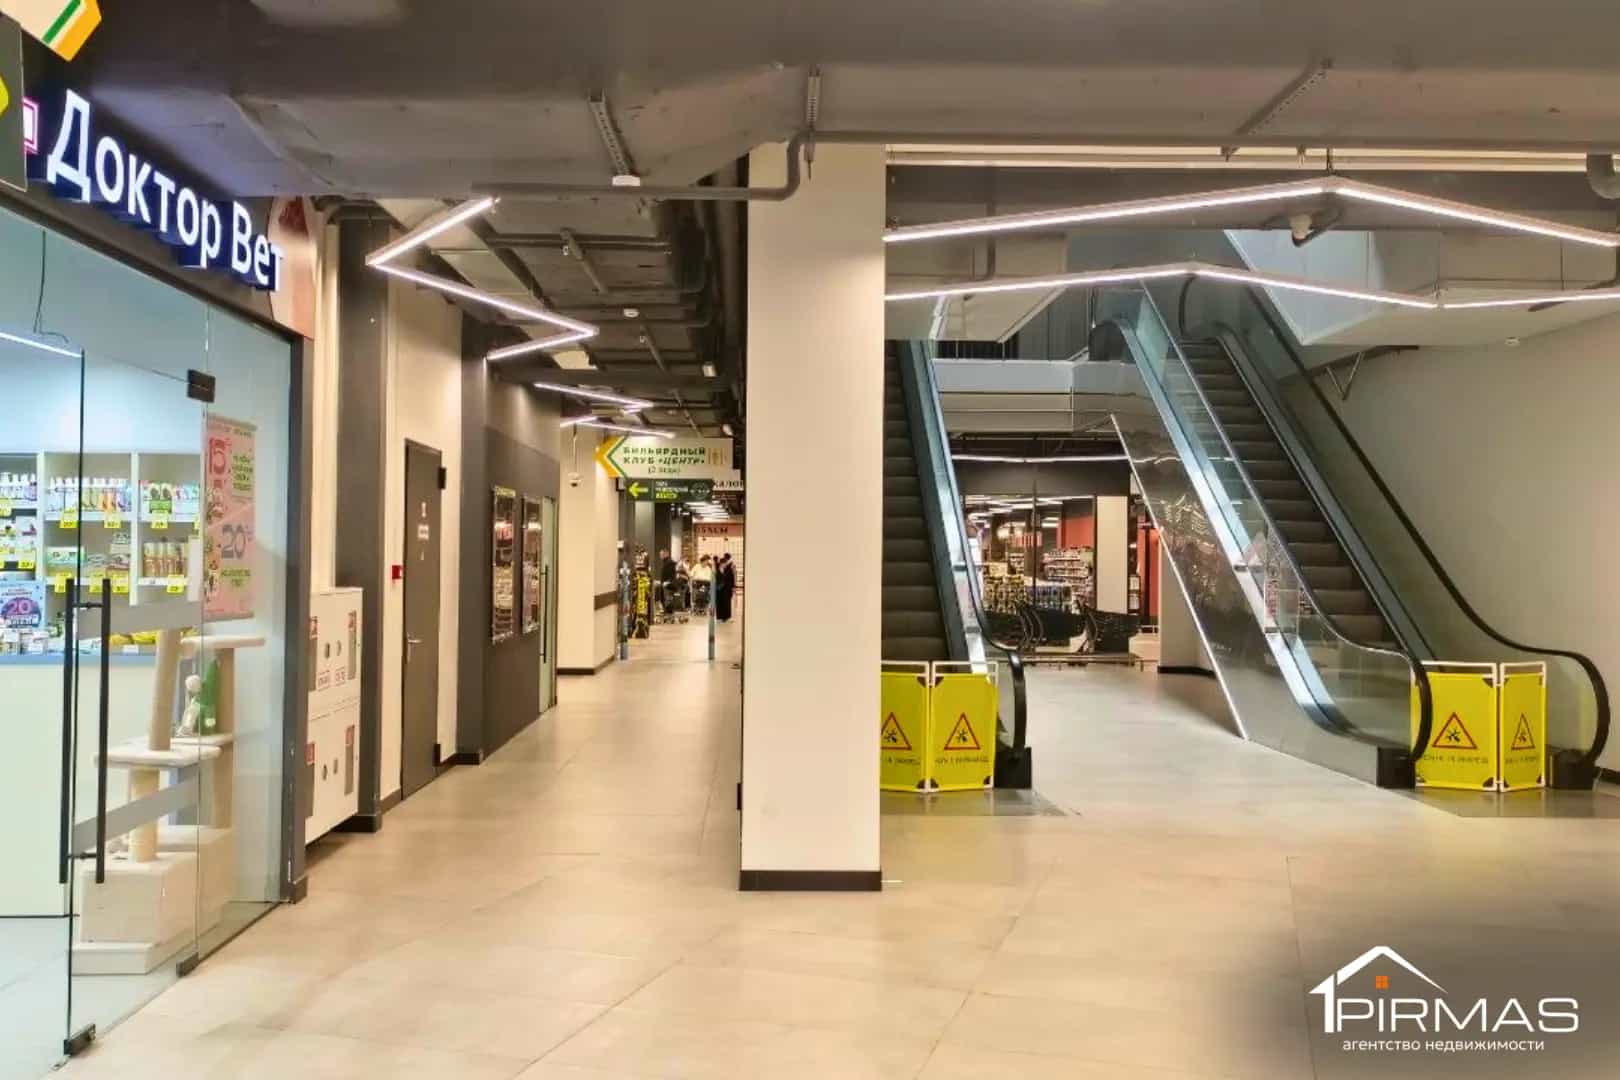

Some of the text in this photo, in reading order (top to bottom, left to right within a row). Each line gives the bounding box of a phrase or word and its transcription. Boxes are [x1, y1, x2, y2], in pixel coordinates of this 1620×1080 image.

[47, 89, 283, 290] Доктор Вет
[623, 447, 706, 455] БИЛЬЯРДНЫЙ
[623, 456, 655, 464] КЛУБ
